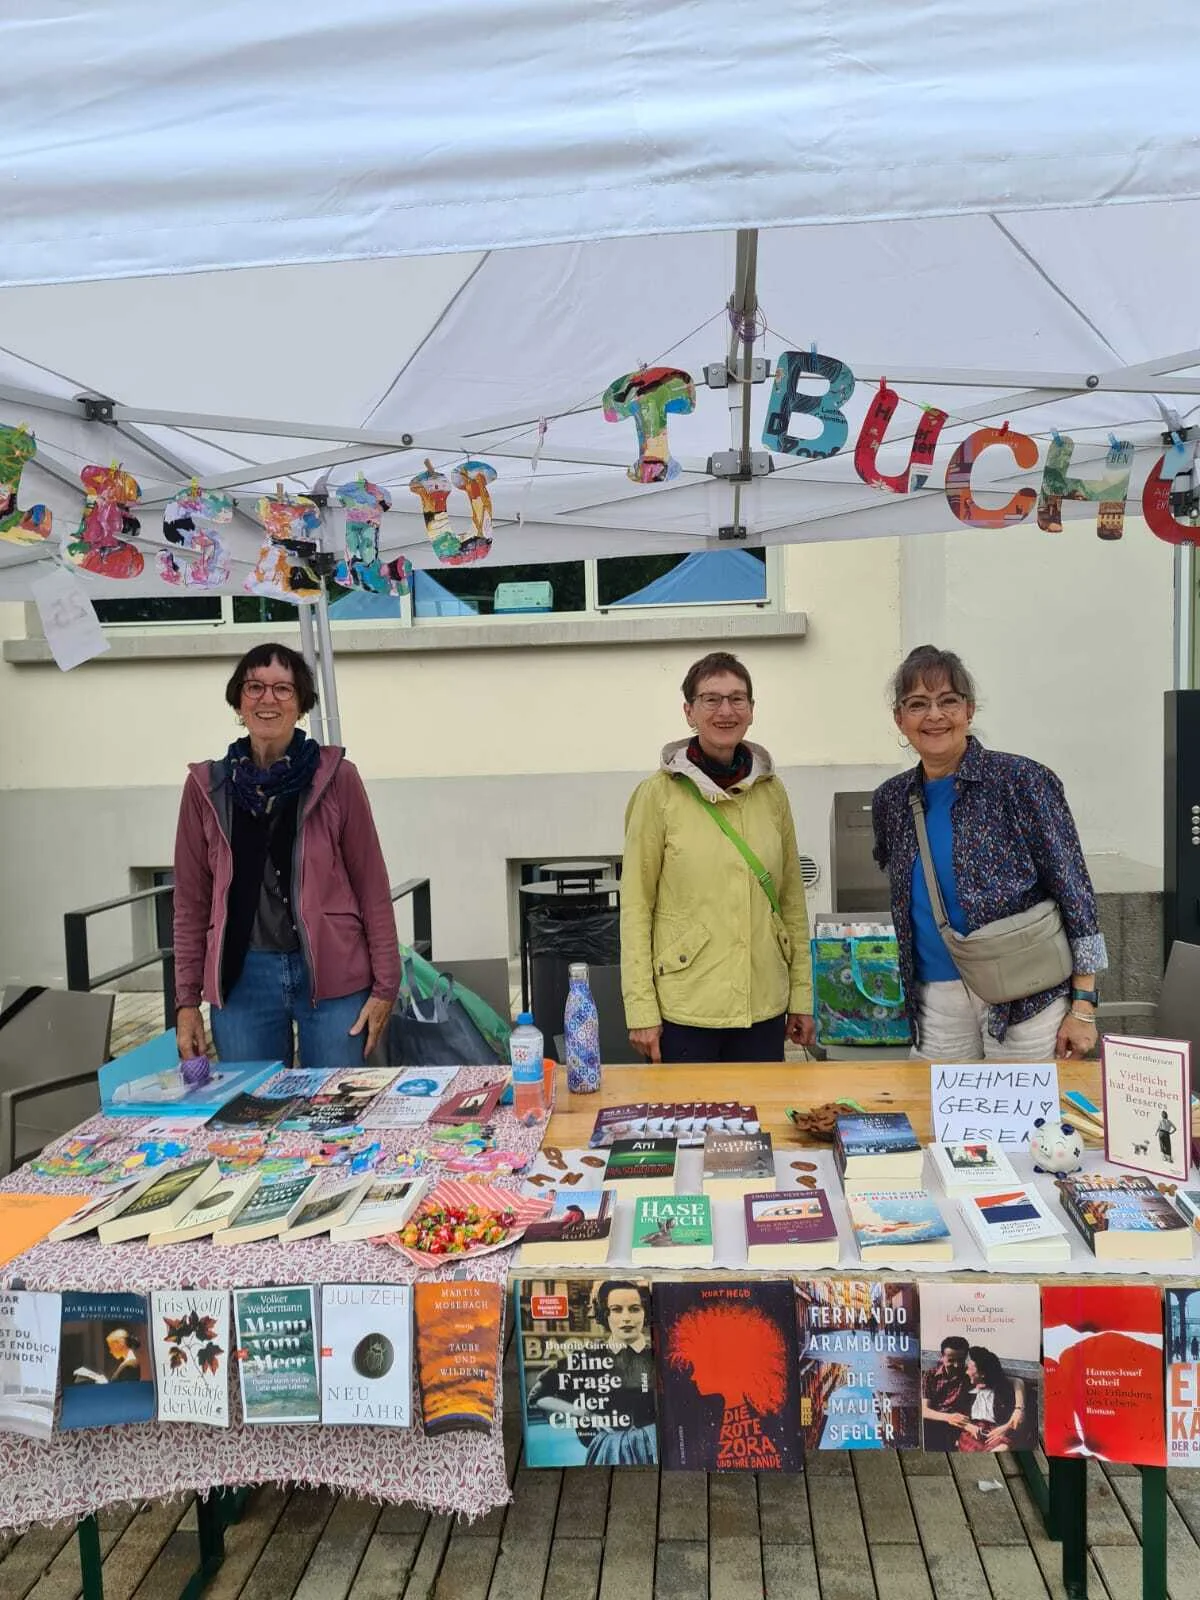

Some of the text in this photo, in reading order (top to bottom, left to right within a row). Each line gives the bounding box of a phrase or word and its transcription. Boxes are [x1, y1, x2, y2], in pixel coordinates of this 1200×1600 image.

[937, 1071, 1051, 1090] NEHMEN
[1119, 1069, 1168, 1087] Vielleicht
[1109, 1078, 1180, 1101] hat das Leben
[939, 1096, 1033, 1116] GEBEN
[1125, 1094, 1168, 1110] Besseres
[1133, 1108, 1151, 1119] vor
[641, 1201, 705, 1218] HASE
[260, 1295, 288, 1304] Volker
[328, 1289, 405, 1306] JULI ZEH
[441, 1289, 481, 1297] MARTIN
[186, 1297, 225, 1317] Wolff
[246, 1303, 303, 1314] Weidermann
[434, 1301, 489, 1310] MOSEBACH
[811, 1306, 907, 1324] FERNANDO
[245, 1317, 307, 1334] Mann
[966, 1325, 997, 1334] Roman
[15, 1330, 31, 1339] DU
[809, 1334, 910, 1352] ARAMBURU
[10, 1341, 57, 1355] ENDLICH
[250, 1336, 301, 1351] vom
[449, 1344, 480, 1353] TAUBE
[252, 1354, 307, 1371] Meer
[567, 1352, 614, 1371] Eine
[558, 1373, 622, 1394] Frage
[847, 1372, 875, 1388] DIE
[1086, 1378, 1120, 1387] Ortheil
[327, 1387, 370, 1401] NEU
[572, 1392, 609, 1411] der
[162, 1397, 186, 1414] der
[351, 1404, 406, 1421] JAHR
[831, 1398, 893, 1414] MAUER
[1086, 1407, 1116, 1416] Roman
[549, 1409, 631, 1429] Chemie
[723, 1406, 750, 1424] DIE
[719, 1418, 762, 1440] ROTE
[829, 1424, 895, 1441] SEGLER
[717, 1434, 777, 1459] ZORA
[1171, 1441, 1189, 1451] DER
